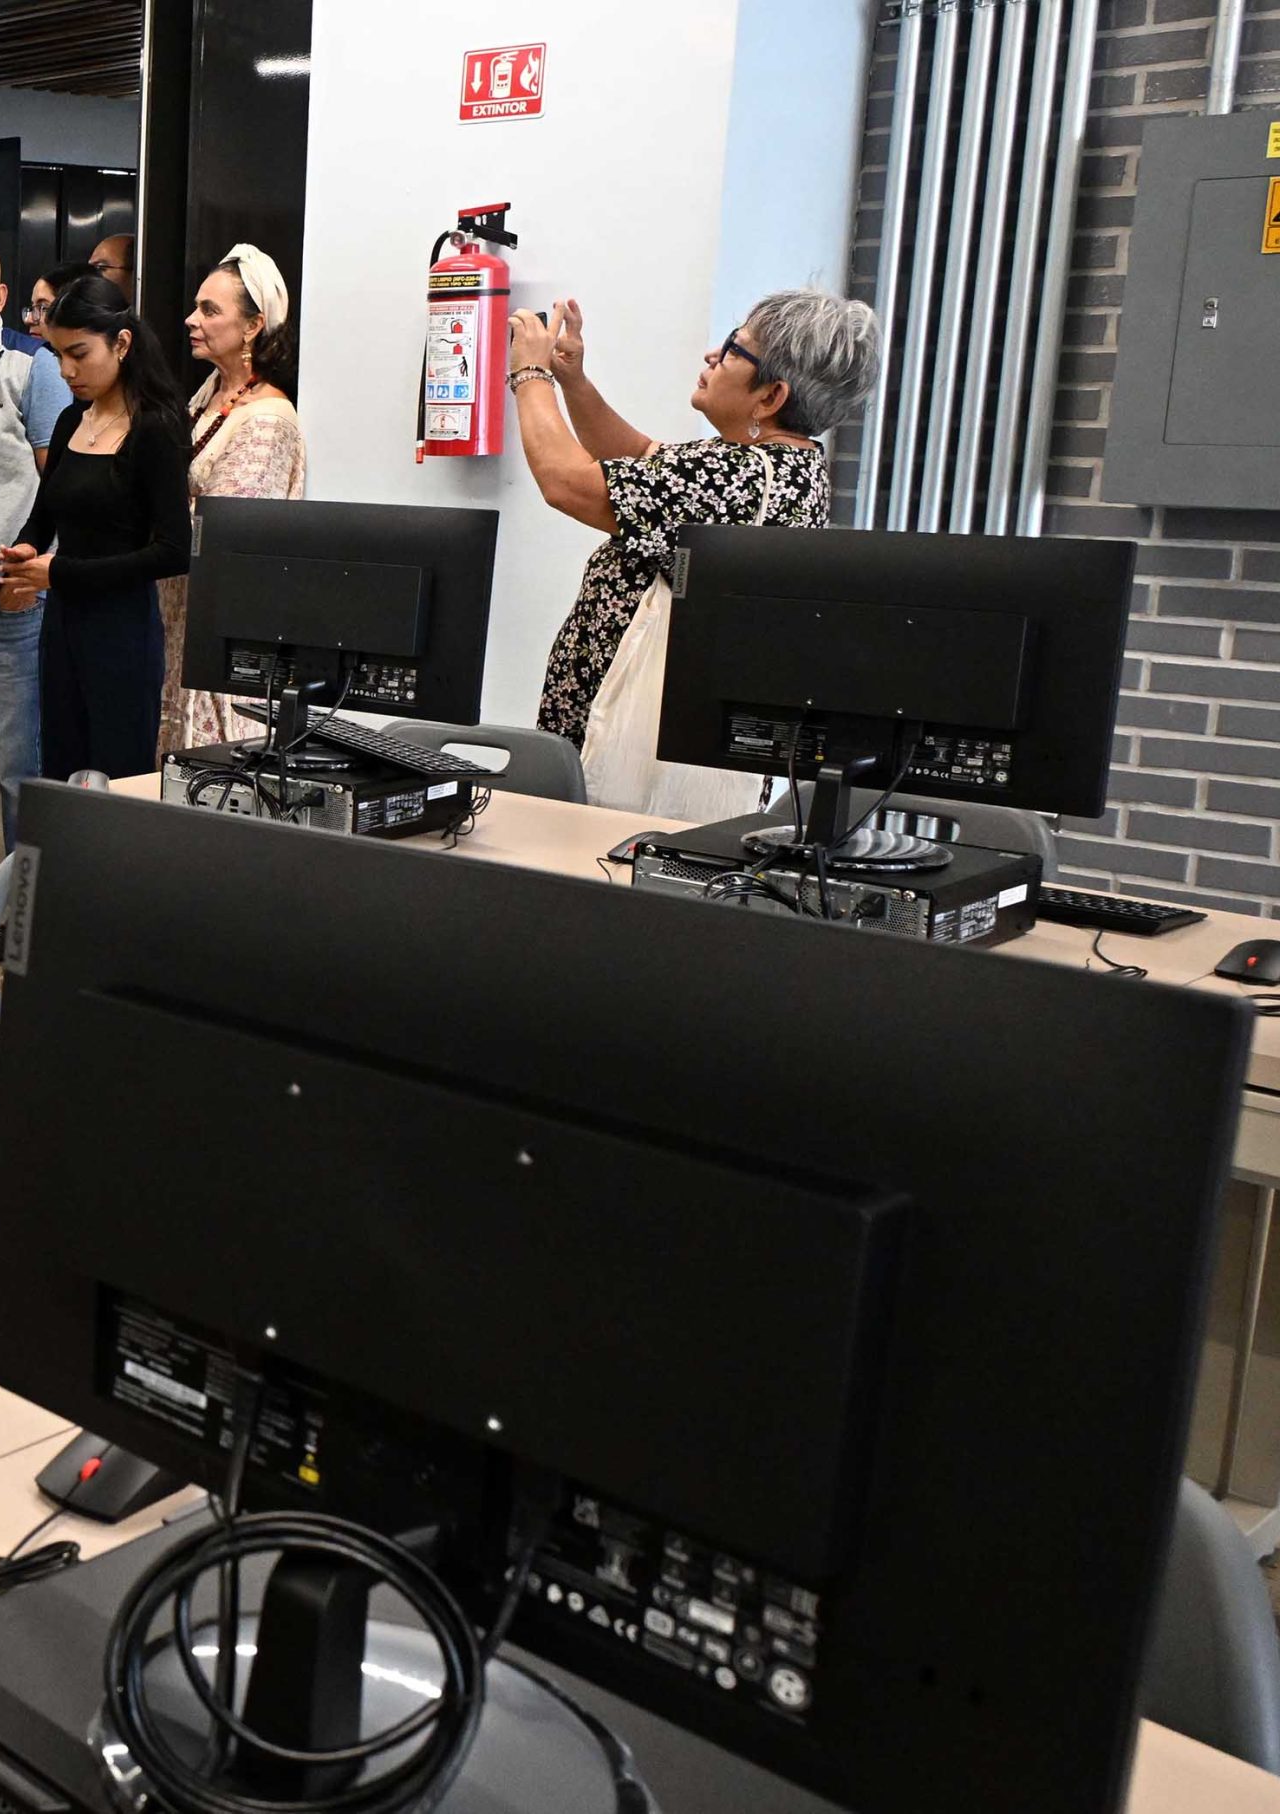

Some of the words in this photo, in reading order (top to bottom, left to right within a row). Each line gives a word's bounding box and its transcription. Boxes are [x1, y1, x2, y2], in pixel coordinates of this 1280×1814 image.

[472, 101, 528, 117] EXTINTOR
[673, 552, 686, 594] Lenovo
[8, 856, 32, 962] Lenovo
